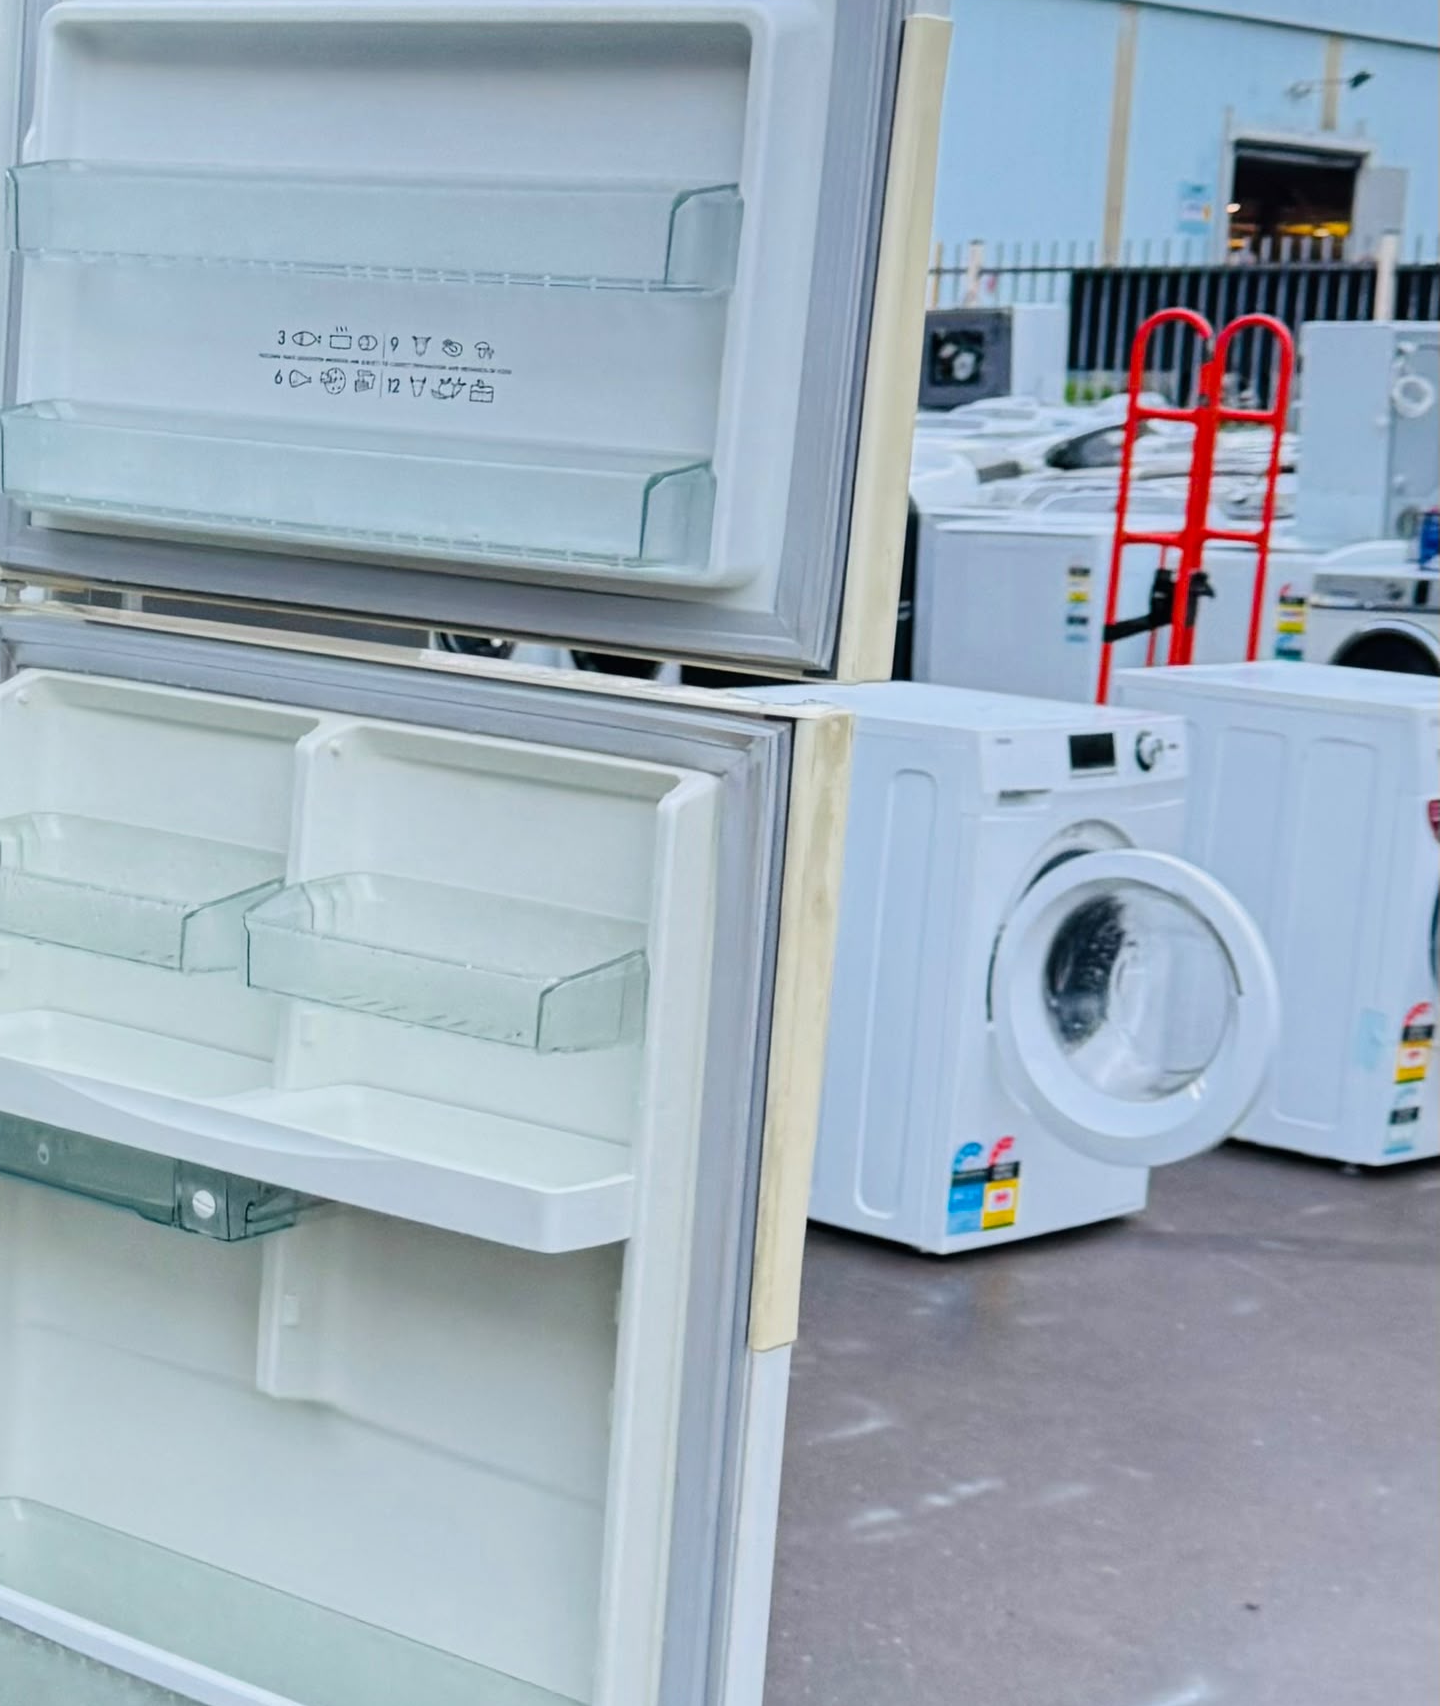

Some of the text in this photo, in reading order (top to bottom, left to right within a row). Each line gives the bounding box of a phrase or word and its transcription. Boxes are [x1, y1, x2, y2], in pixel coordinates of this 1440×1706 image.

[277, 330, 286, 346] 3
[390, 337, 399, 352] 9
[274, 369, 283, 385] 6
[387, 378, 401, 394] 12
